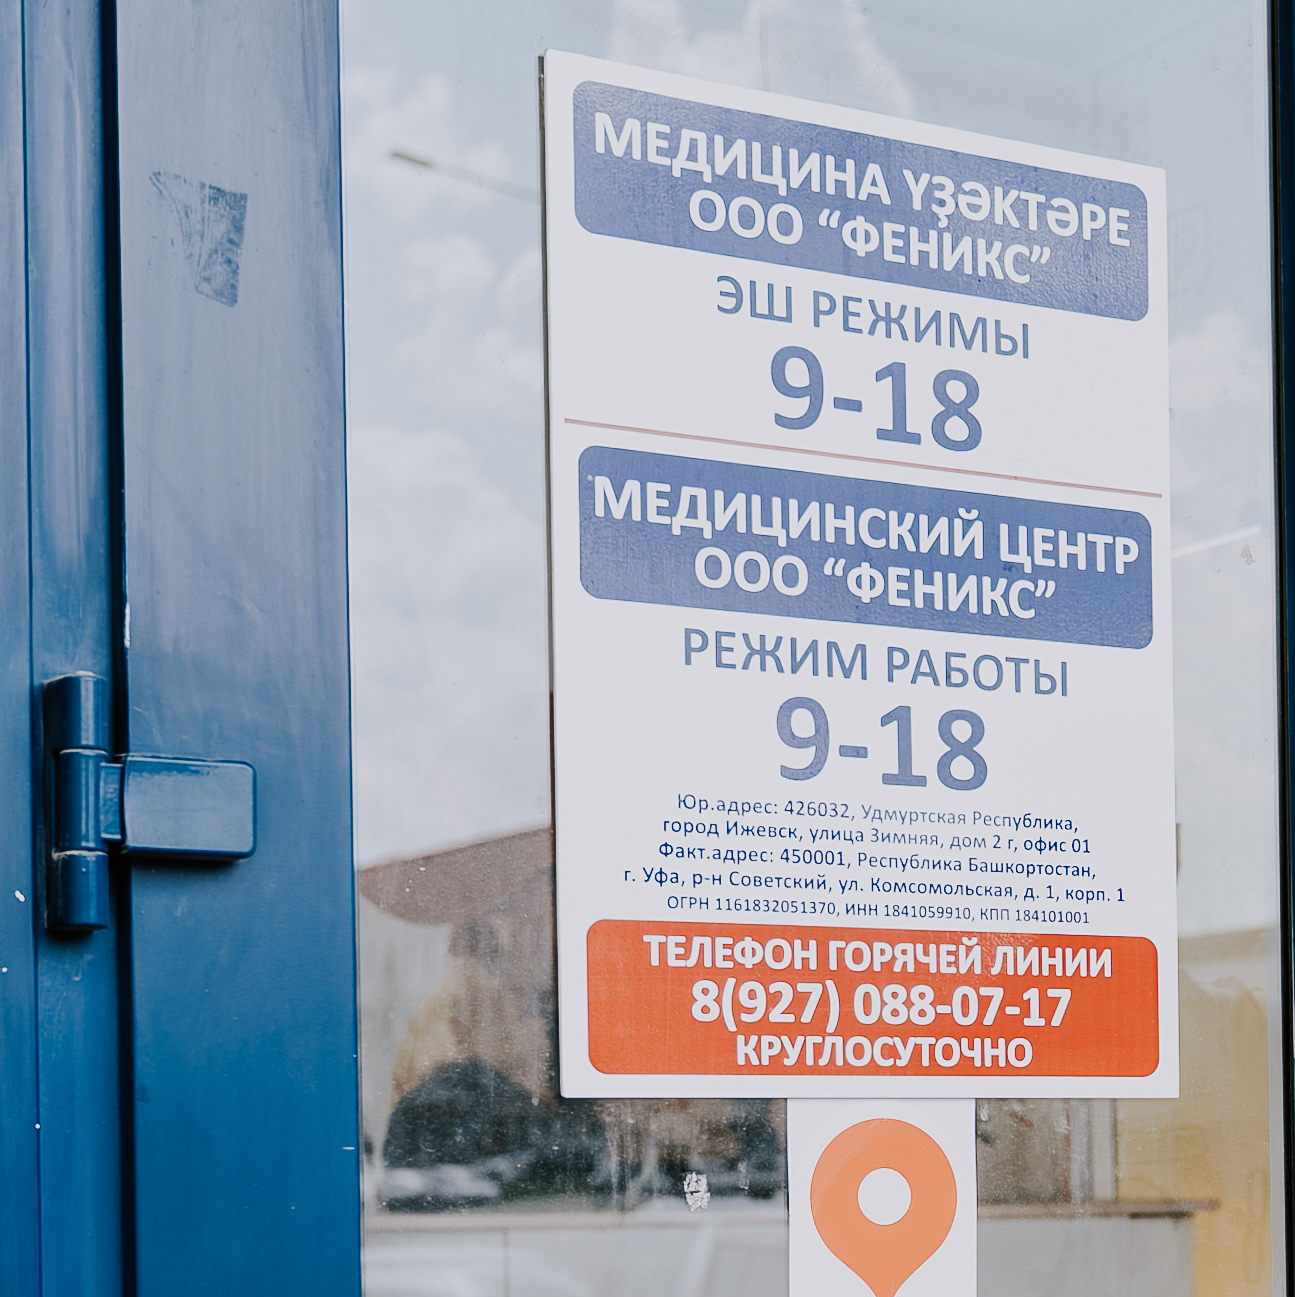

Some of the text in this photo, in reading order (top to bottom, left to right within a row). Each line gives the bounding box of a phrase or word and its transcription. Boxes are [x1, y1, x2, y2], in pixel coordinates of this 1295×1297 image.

[595, 112, 891, 205] МЕДИЦИНА
[690, 190, 803, 244] ООО
[717, 276, 1029, 359] ЭШ РЕЖИМЫ
[771, 346, 982, 452] 9-18
[595, 476, 1138, 574] МЕДИЦИНСКИЙ ЦЕНТР
[695, 547, 808, 596] ООО
[684, 628, 1067, 696] РЕЖИМ РАБОТЫ
[777, 697, 987, 791] 9-18
[663, 820, 1091, 855] город Ижевск, улица Зимняя, дом 2 г, офис 01
[678, 794, 1078, 833] Юр.адрес: 426032, Удмуртская Республика,
[624, 867, 1125, 904] г. Уфа, р-н Советский, ул. Комсомольская, д. 1, корп. 1
[659, 842, 1096, 879] Факт.адрес: 450001, Республика Башкортостан,
[667, 895, 1090, 924] ОГРН 1161832051370, ИНН 1841059910, КПП 184101001
[643, 935, 1111, 977] ТЕЛЕФОН ГОРЯЧЕЙ ЛИНИИ
[692, 978, 1071, 1033] 8(927) 088-07-17
[737, 1035, 1032, 1067] КРУГЛОСУТОЧНО
